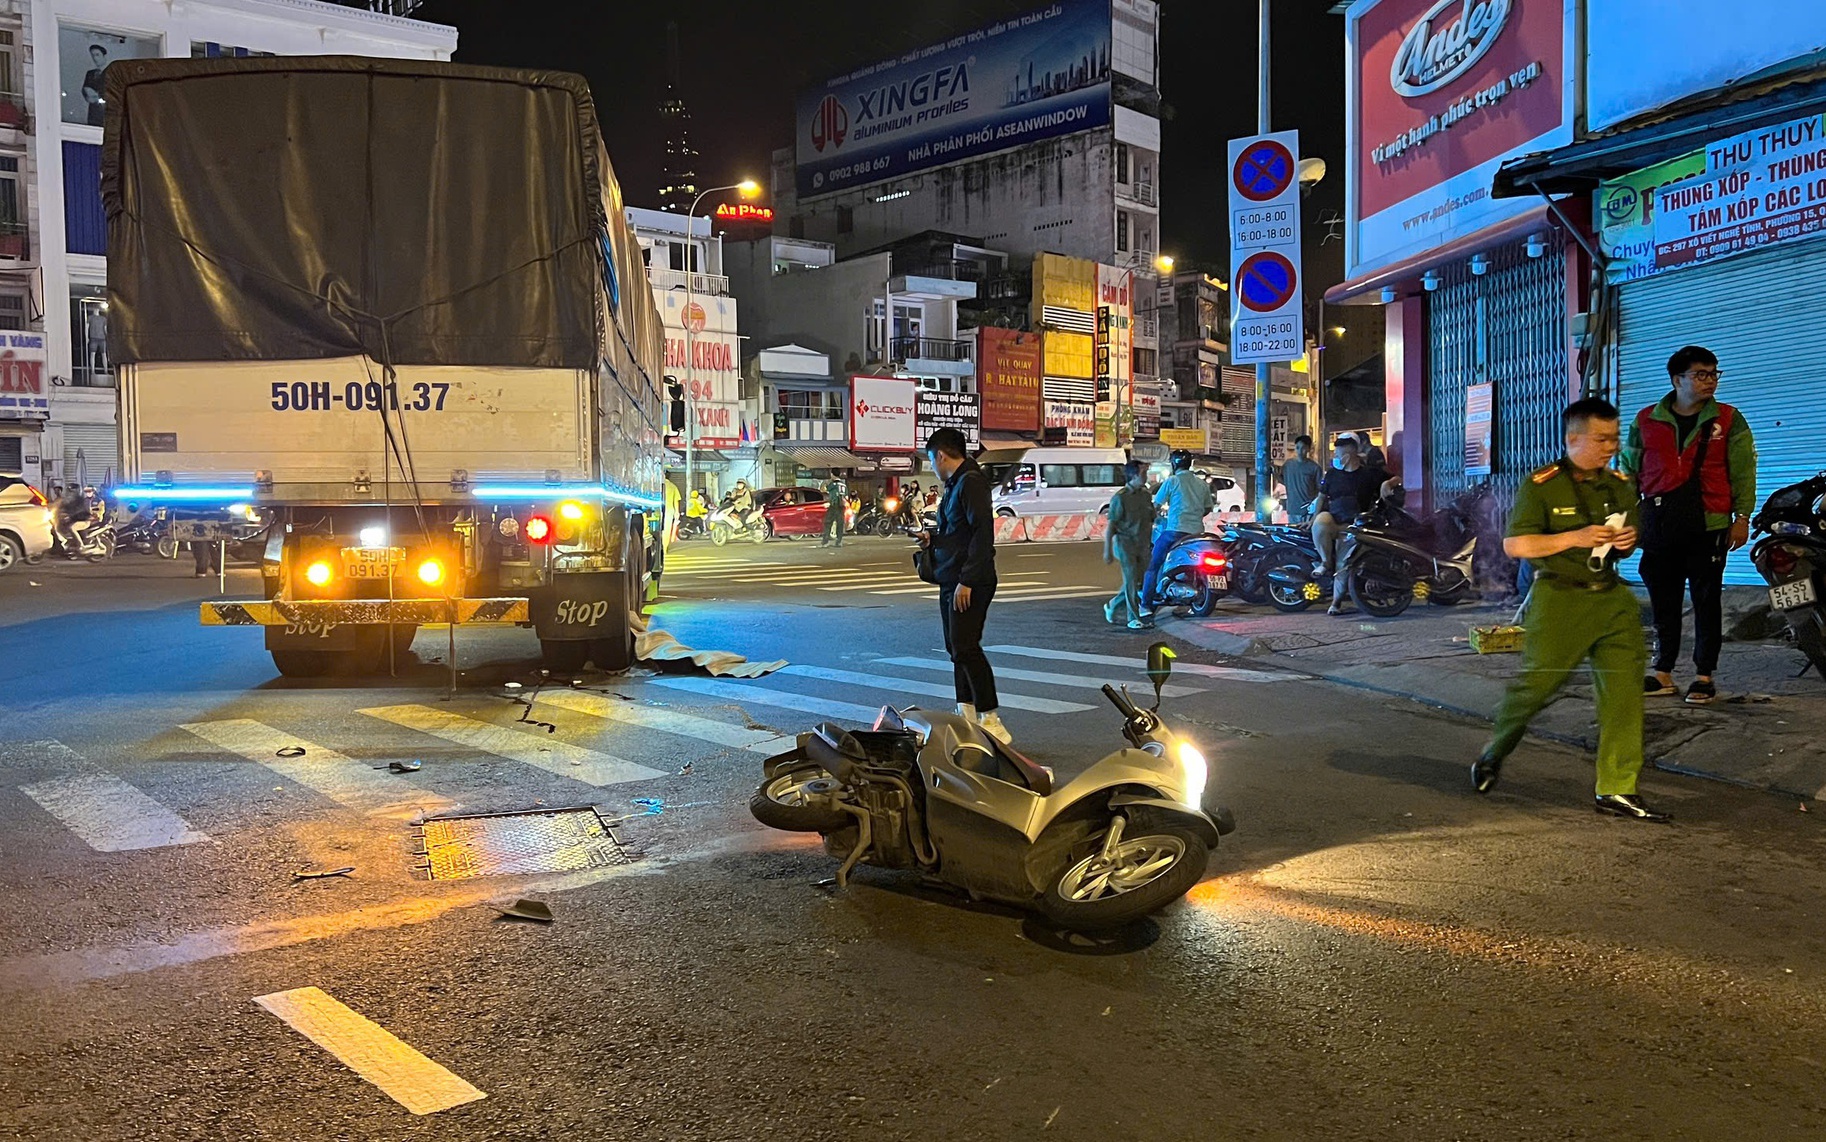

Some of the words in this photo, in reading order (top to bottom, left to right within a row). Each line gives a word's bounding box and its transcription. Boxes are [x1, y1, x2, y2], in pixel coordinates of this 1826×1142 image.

[1007, 18, 1020, 29] TIN
[1021, 12, 1044, 27] TOÀN
[1419, 48, 1466, 85] HELMET
[855, 62, 970, 124] XINGFA
[1385, 132, 1408, 158] một
[1408, 115, 1439, 147] hạnh
[1440, 96, 1473, 131] phúc
[1474, 76, 1506, 106] trọn
[1508, 60, 1538, 89] vẹn
[908, 145, 931, 162] NHÀ
[933, 134, 964, 156] PHÂN
[965, 123, 994, 147] PHỐI
[996, 104, 1088, 140] ASEANWINDOW
[829, 166, 852, 182] 0902
[853, 162, 872, 178] 988
[872, 156, 891, 172] 667
[1661, 181, 1713, 213] THÙNG
[1718, 167, 1750, 198] XỐP
[1240, 210, 1287, 226] 6:00-8:00
[1688, 204, 1722, 233] TẤM
[1727, 194, 1759, 224] XỐP
[1765, 182, 1801, 212] CÁC
[1237, 227, 1292, 243] 16:00-18:00
[1777, 224, 1800, 239] 0938
[1802, 219, 1819, 232] 435
[1613, 237, 1655, 260] Chuy
[1241, 322, 1292, 337] 8:00-16:00
[692, 339, 733, 372] KHOA
[1238, 338, 1296, 353] 18:00-22:00
[271, 381, 451, 412] 50H-091.37
[697, 408, 730, 428] XANH
[870, 405, 914, 415] CLICKBUY
[917, 401, 951, 416] HOÀNG
[952, 404, 978, 417] LONG
[349, 564, 398, 577] 091.37
[1774, 581, 1807, 599] 54-S5
[555, 600, 608, 627] Stop
